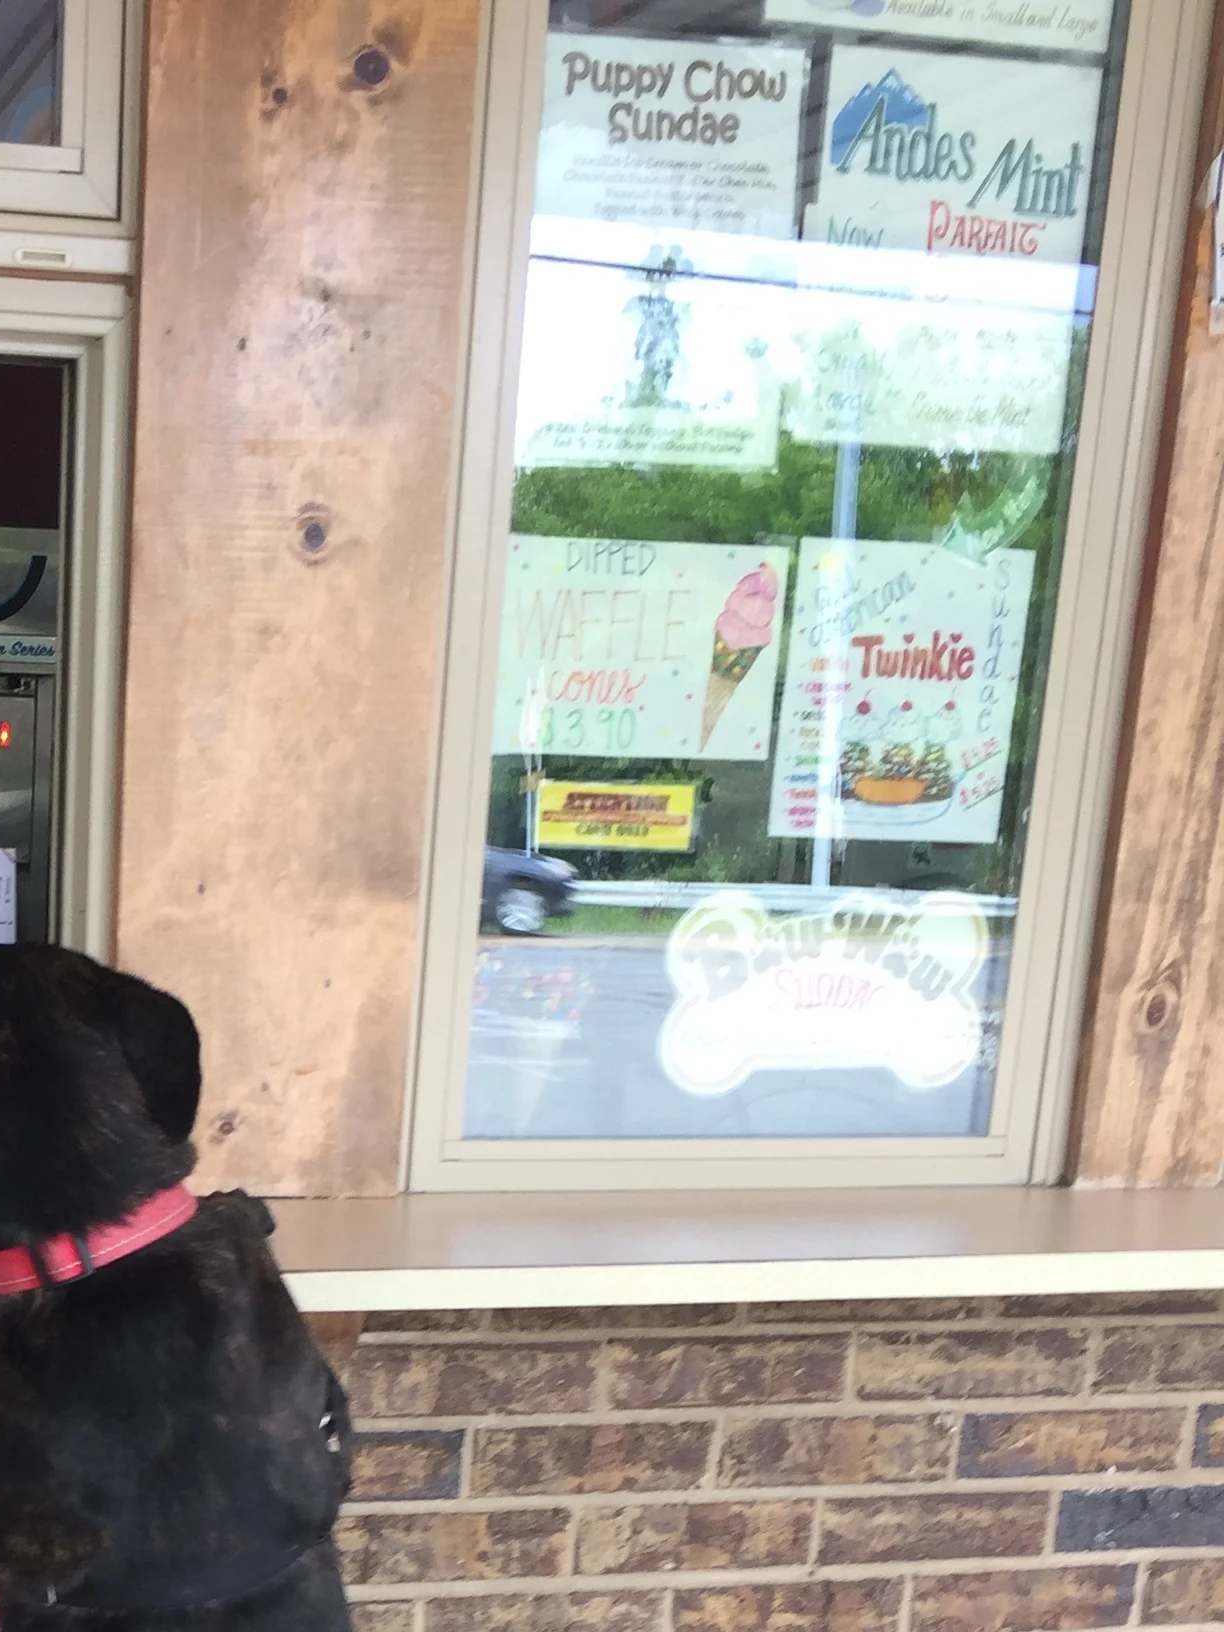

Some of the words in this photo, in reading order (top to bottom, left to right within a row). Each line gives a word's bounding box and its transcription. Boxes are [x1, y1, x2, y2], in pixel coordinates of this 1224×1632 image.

[960, 7, 974, 21] in
[1027, 6, 1057, 28] and
[1057, 5, 1098, 40] Large
[562, 51, 675, 100] Puppy
[684, 59, 787, 102] Chow
[608, 102, 740, 149] Sundae
[836, 95, 976, 182] Andes
[966, 137, 1084, 217] Mint
[926, 200, 1047, 255] PARFAIT
[566, 541, 656, 576] DIPPED
[9, 641, 56, 657] Series
[516, 588, 691, 662] WAFFLE
[851, 630, 976, 681] Twinkie
[548, 668, 647, 705] cones
